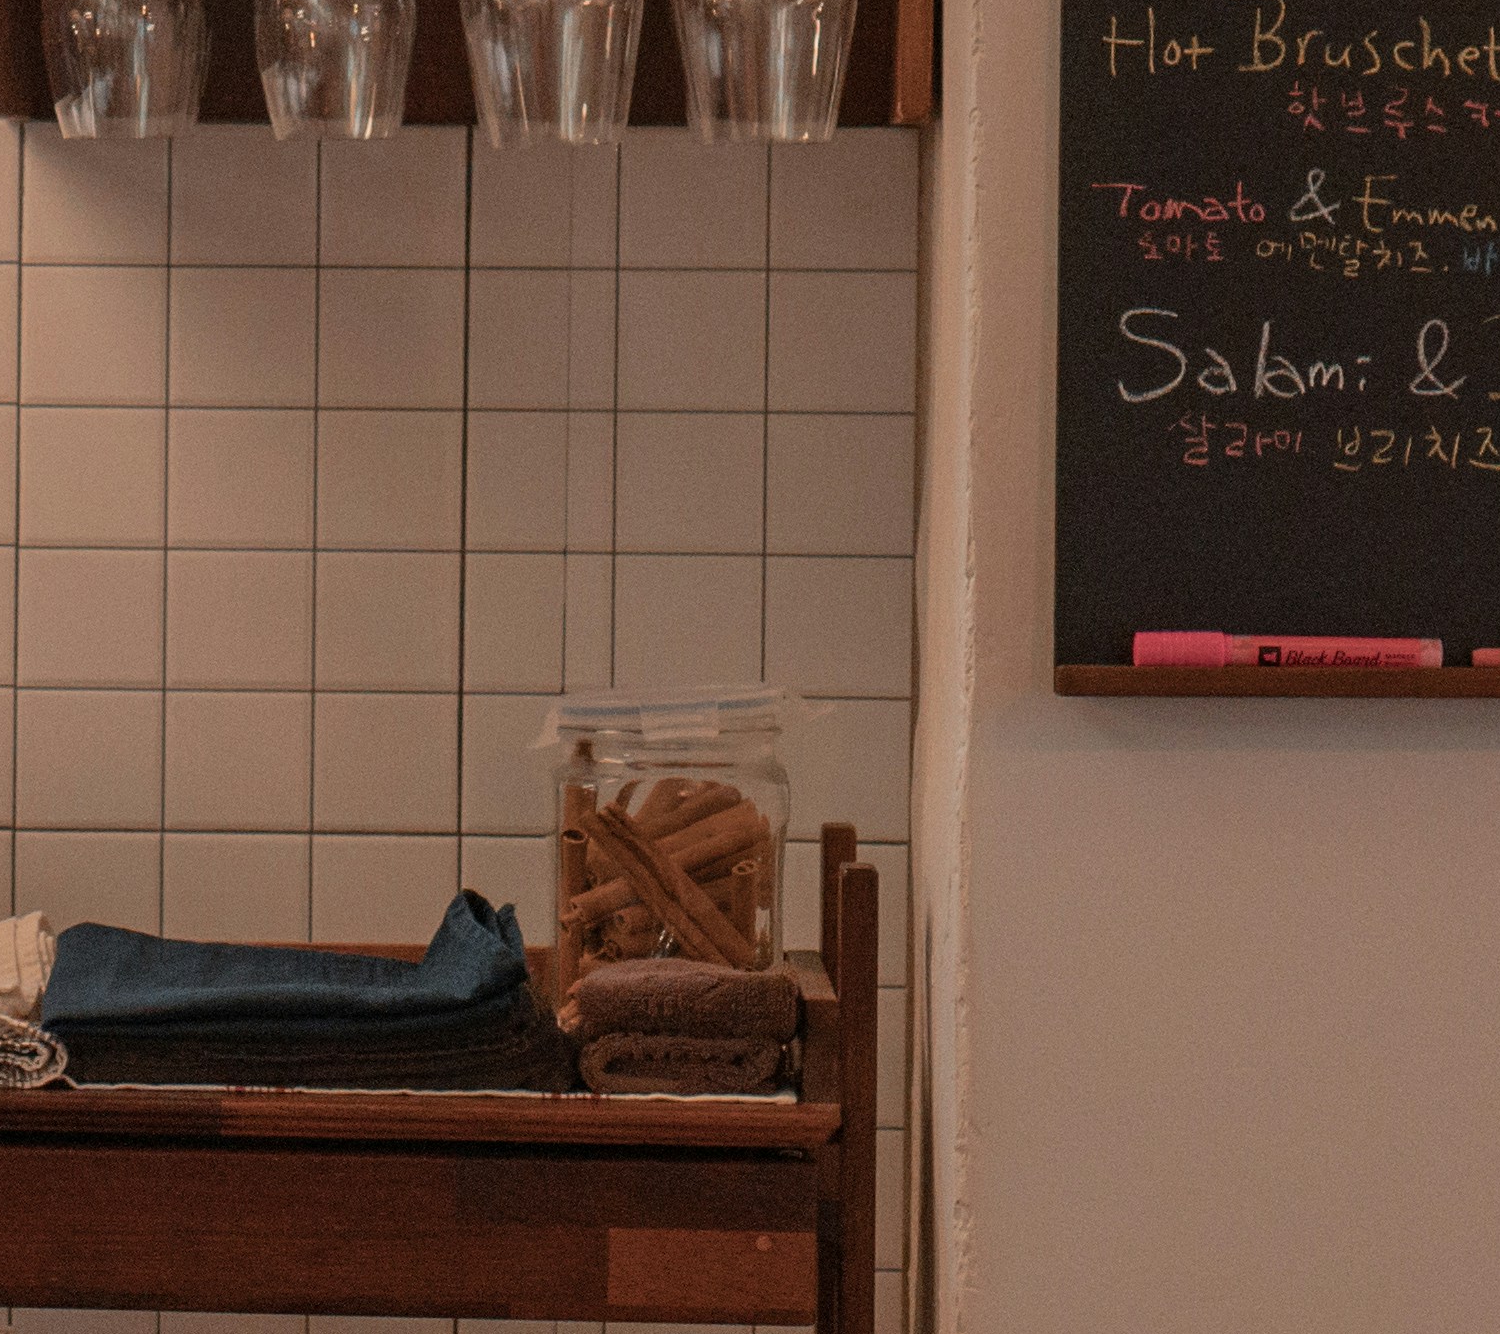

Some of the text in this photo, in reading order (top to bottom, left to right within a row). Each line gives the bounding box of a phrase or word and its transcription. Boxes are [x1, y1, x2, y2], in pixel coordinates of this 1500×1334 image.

[1102, 7, 1214, 77] Hot
[1091, 181, 1265, 222] Tomato
[1289, 168, 1341, 224] &
[1138, 232, 1224, 261] 토마토
[1118, 307, 1372, 403] Salami
[1409, 319, 1467, 399] &
[1168, 411, 1303, 467] 살라미
[1285, 651, 1326, 666] Black
